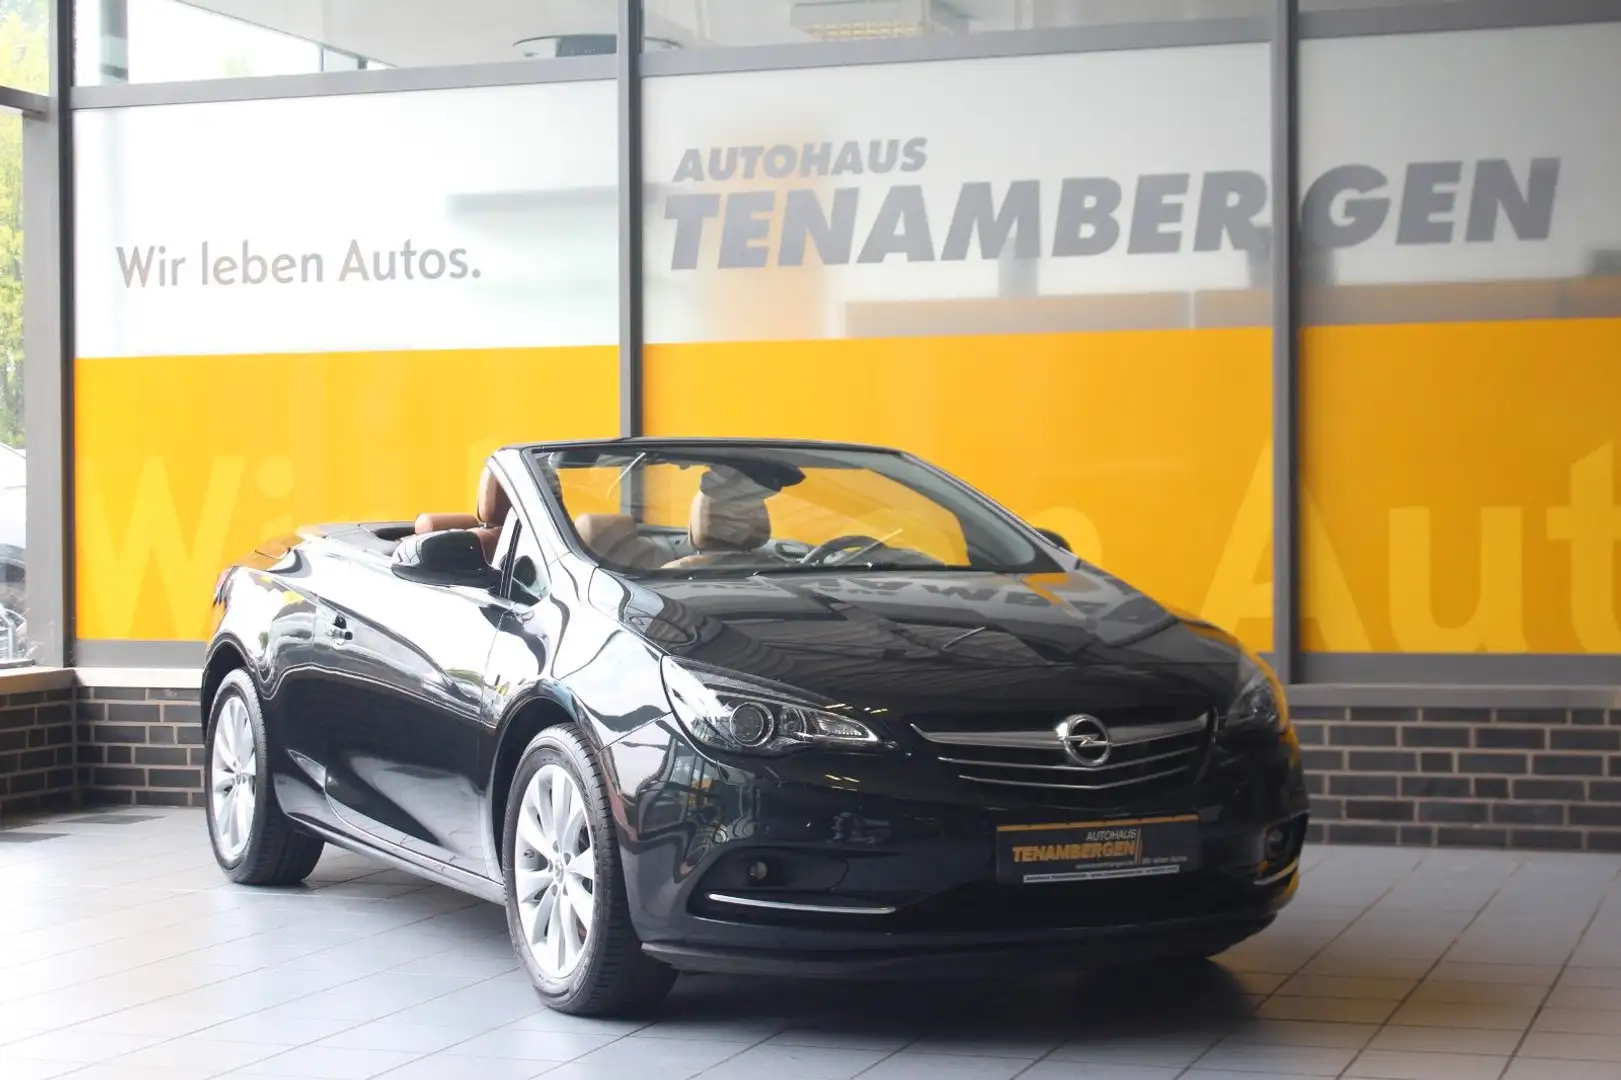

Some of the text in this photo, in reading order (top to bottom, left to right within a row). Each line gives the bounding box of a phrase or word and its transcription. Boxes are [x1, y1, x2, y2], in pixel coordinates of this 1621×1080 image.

[672, 137, 928, 183] AUTOHAUS
[664, 157, 1562, 271] TENAMBERGEN
[115, 238, 482, 288] Wir leben Autos.
[1012, 840, 1137, 863] TENAMBERGEN
[1085, 827, 1138, 841] AUTOHAUS
